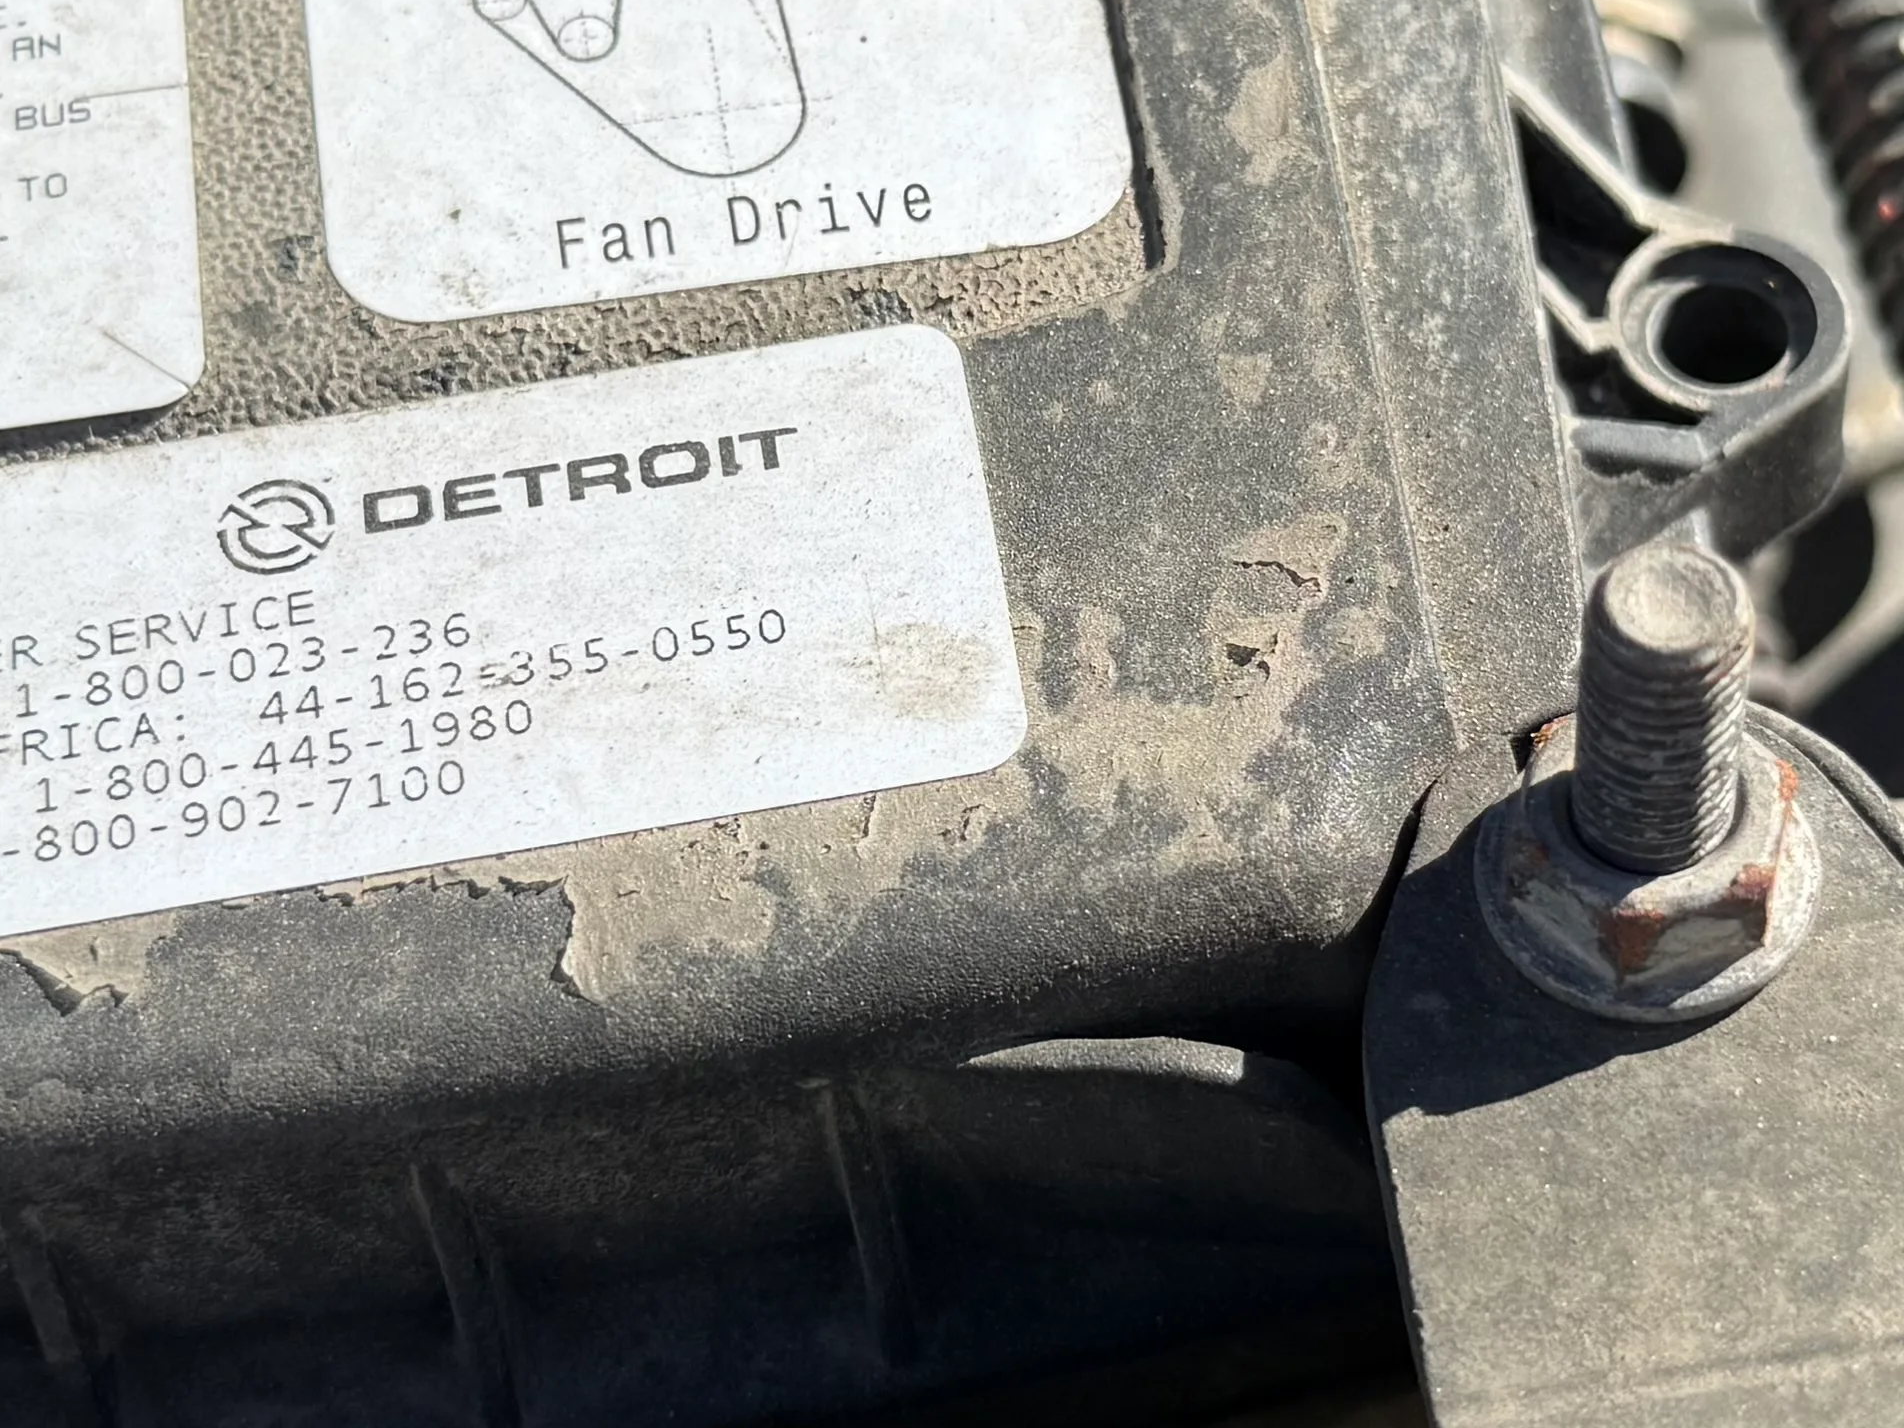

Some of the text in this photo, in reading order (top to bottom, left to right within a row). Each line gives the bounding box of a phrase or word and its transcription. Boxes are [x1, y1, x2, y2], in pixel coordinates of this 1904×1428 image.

[10, 29, 62, 64] AN
[12, 94, 92, 133] BUS
[16, 169, 69, 205] TO
[557, 177, 934, 271] Fan Drive
[364, 427, 798, 534] DETROIT
[15, 611, 472, 718] 1-800-023-236
[75, 589, 317, 661] SERVICE
[260, 606, 788, 726] 44-162-355-0550
[35, 699, 534, 815] 1-800-445-1980
